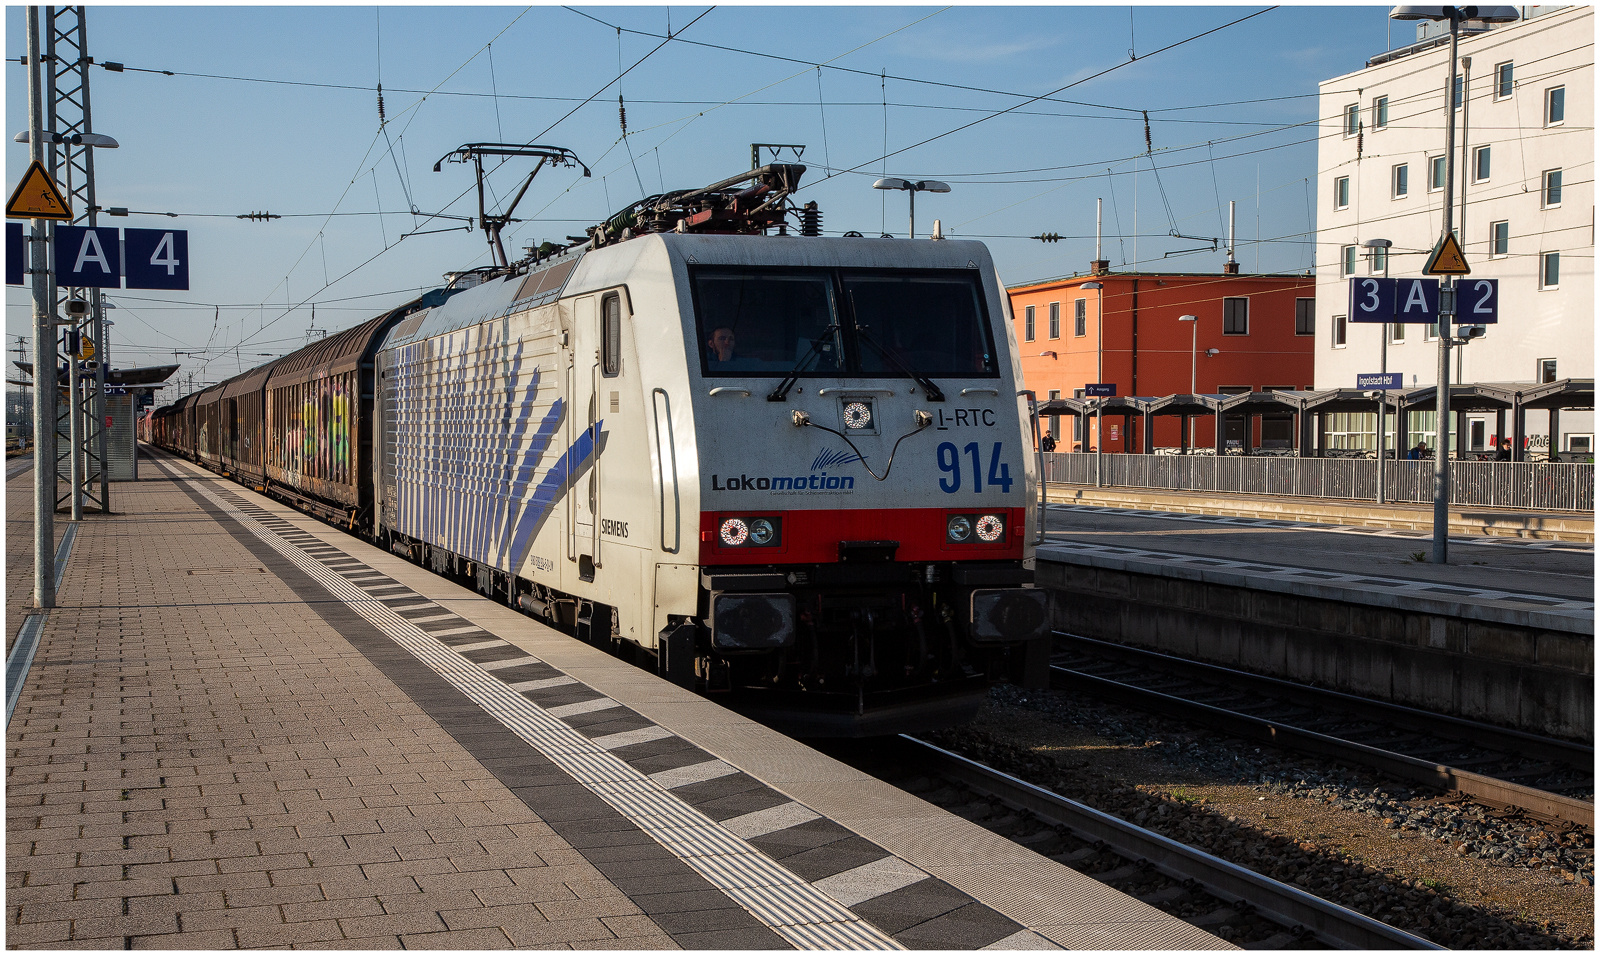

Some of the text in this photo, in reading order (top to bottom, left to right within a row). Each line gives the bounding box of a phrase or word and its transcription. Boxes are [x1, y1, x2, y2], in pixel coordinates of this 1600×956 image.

[73, 229, 180, 276] A 4
[1359, 278, 1493, 314] 3 A 2
[1359, 375, 1393, 387] Ingolstadt Hbf
[937, 408, 996, 430] I-RTC
[1528, 434, 1550, 448] Hote
[936, 441, 1013, 494] 914
[711, 471, 855, 491] Lokomotion
[601, 518, 629, 539] SIEMENS
